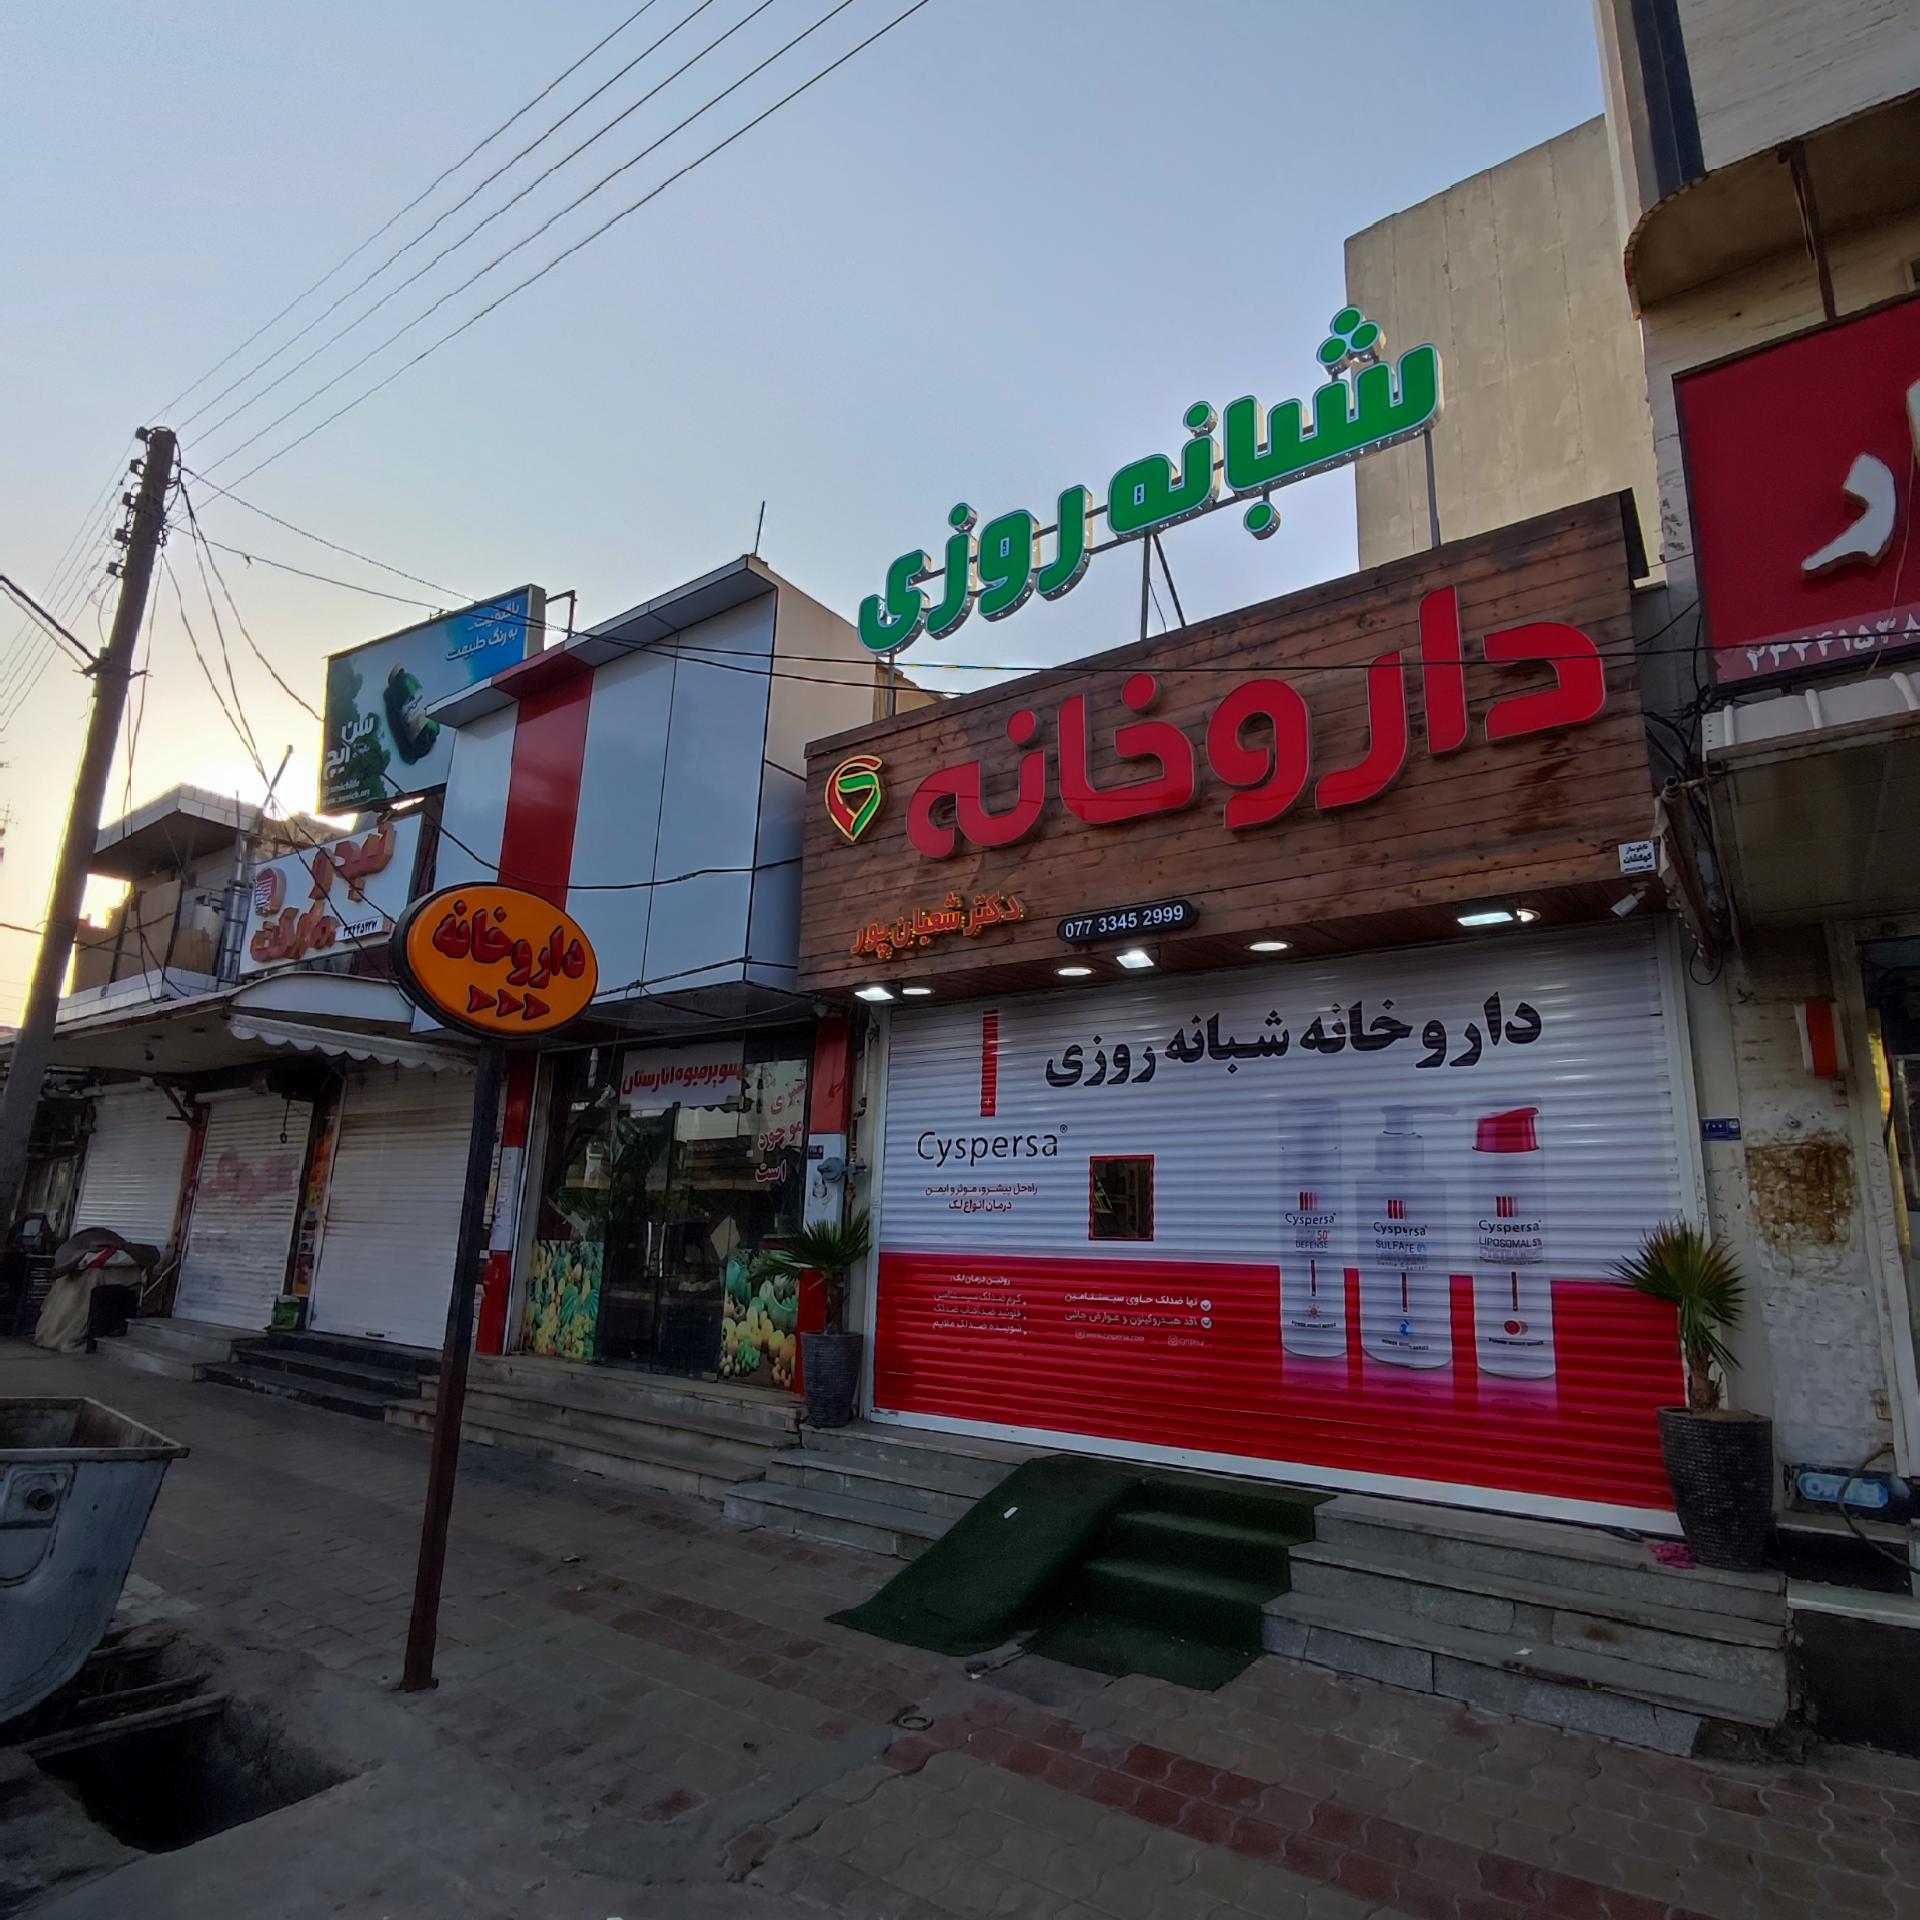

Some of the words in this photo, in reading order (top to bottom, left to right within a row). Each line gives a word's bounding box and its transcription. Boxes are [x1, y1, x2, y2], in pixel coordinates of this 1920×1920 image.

[1107, 304, 1444, 541] شبانه
[858, 483, 1093, 656] روزی
[906, 585, 1606, 859] داروخانه
[850, 919, 894, 960] پور
[890, 890, 962, 947] شعبان
[963, 891, 1026, 938] دکتر
[1064, 918, 1093, 940] 077
[1097, 912, 1138, 934] 3345
[1142, 904, 1185, 928] 2999
[432, 899, 586, 990] داروخانه
[1164, 1009, 1290, 1075] شبانه
[1299, 991, 1543, 1069] داروخانه
[1044, 1034, 1158, 1089] روزی
[754, 1158, 788, 1184] است
[948, 1198, 963, 1210] لک
[962, 1199, 985, 1214] انواع
[985, 1199, 1012, 1213] درمان
[1478, 1236, 1532, 1249] LIPOSOMAL
